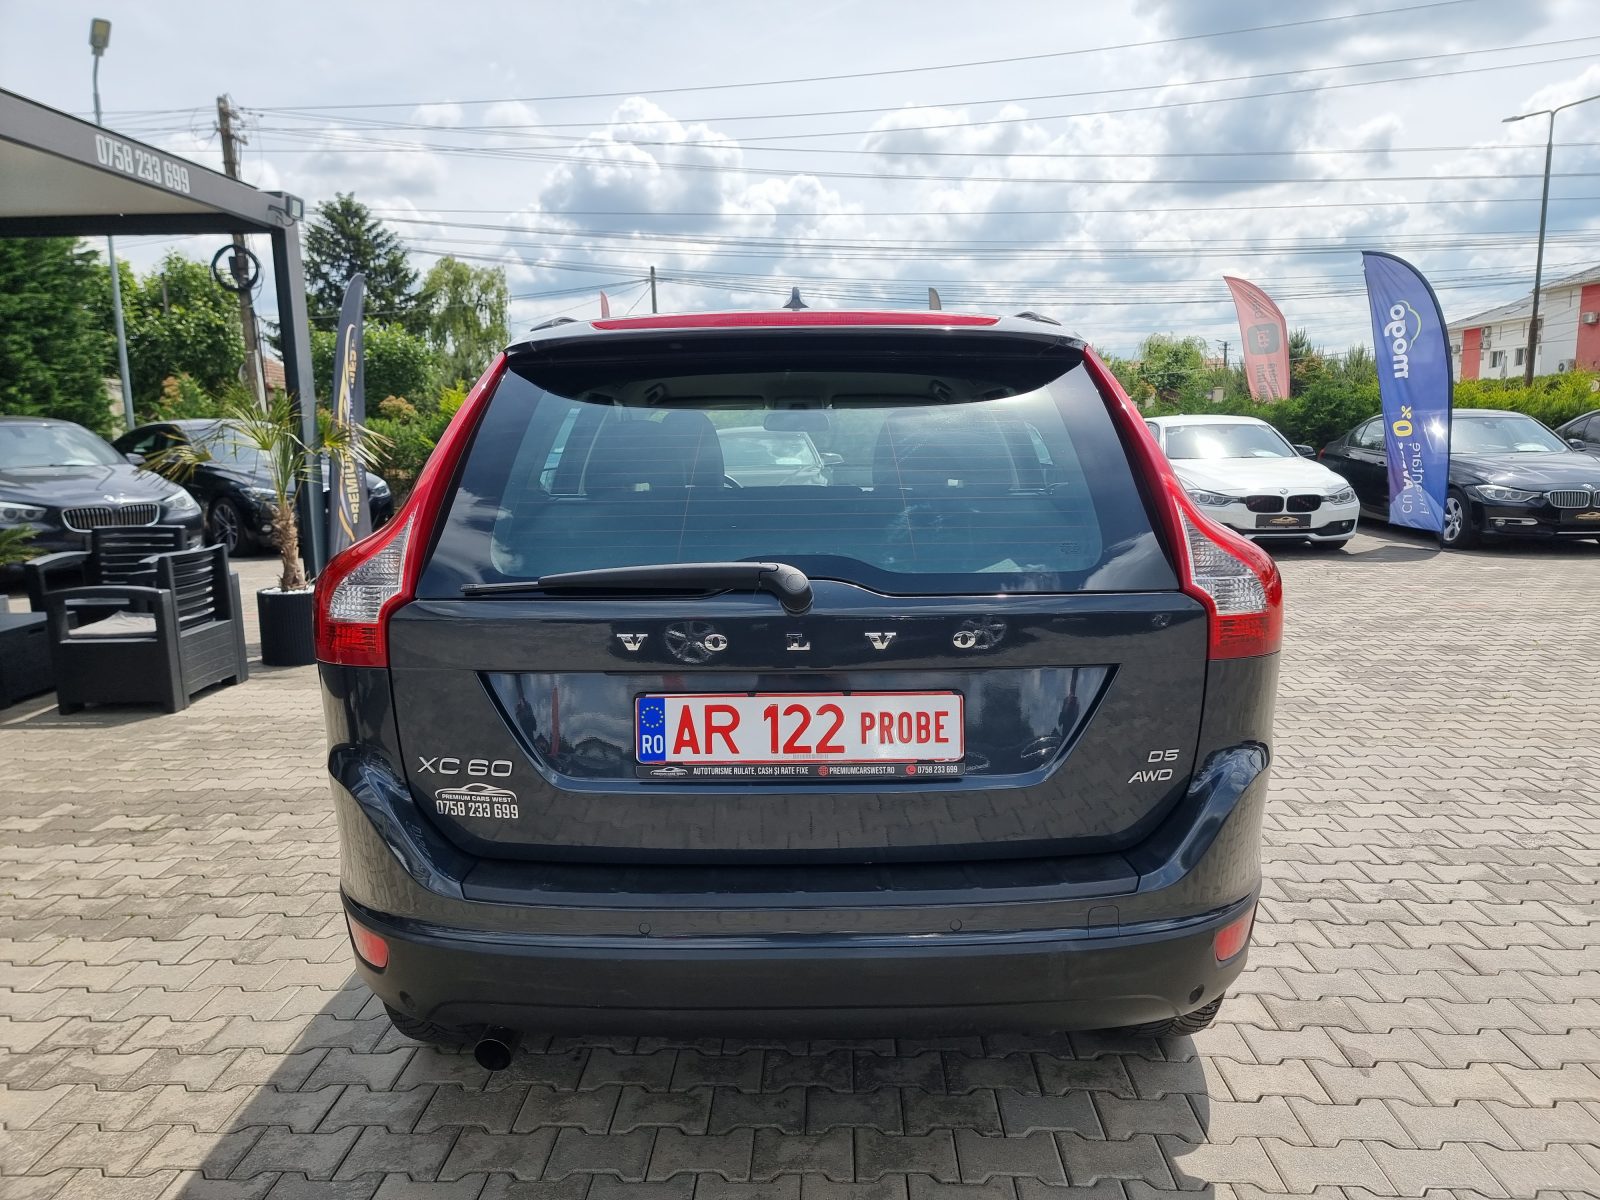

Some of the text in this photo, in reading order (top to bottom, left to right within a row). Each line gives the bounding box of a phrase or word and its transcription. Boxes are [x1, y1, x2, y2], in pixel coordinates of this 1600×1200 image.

[95, 133, 191, 194] 0758 233 699
[616, 632, 977, 652] VOLVO
[642, 703, 949, 755] RO AR 122 PROBE
[1147, 748, 1180, 763] D5
[693, 767, 733, 776] AUTOTURISME
[733, 766, 757, 776] RULATE,
[757, 766, 773, 775] CASH
[780, 766, 796, 775] RATE
[796, 765, 809, 775] FIXE
[829, 765, 895, 775] PREMIUMCARSWEST.RO
[917, 764, 958, 774] 0758 233 699
[1127, 768, 1174, 784] AWD
[441, 793, 471, 801] PREMIUM
[435, 799, 519, 819] 0758 233 699
